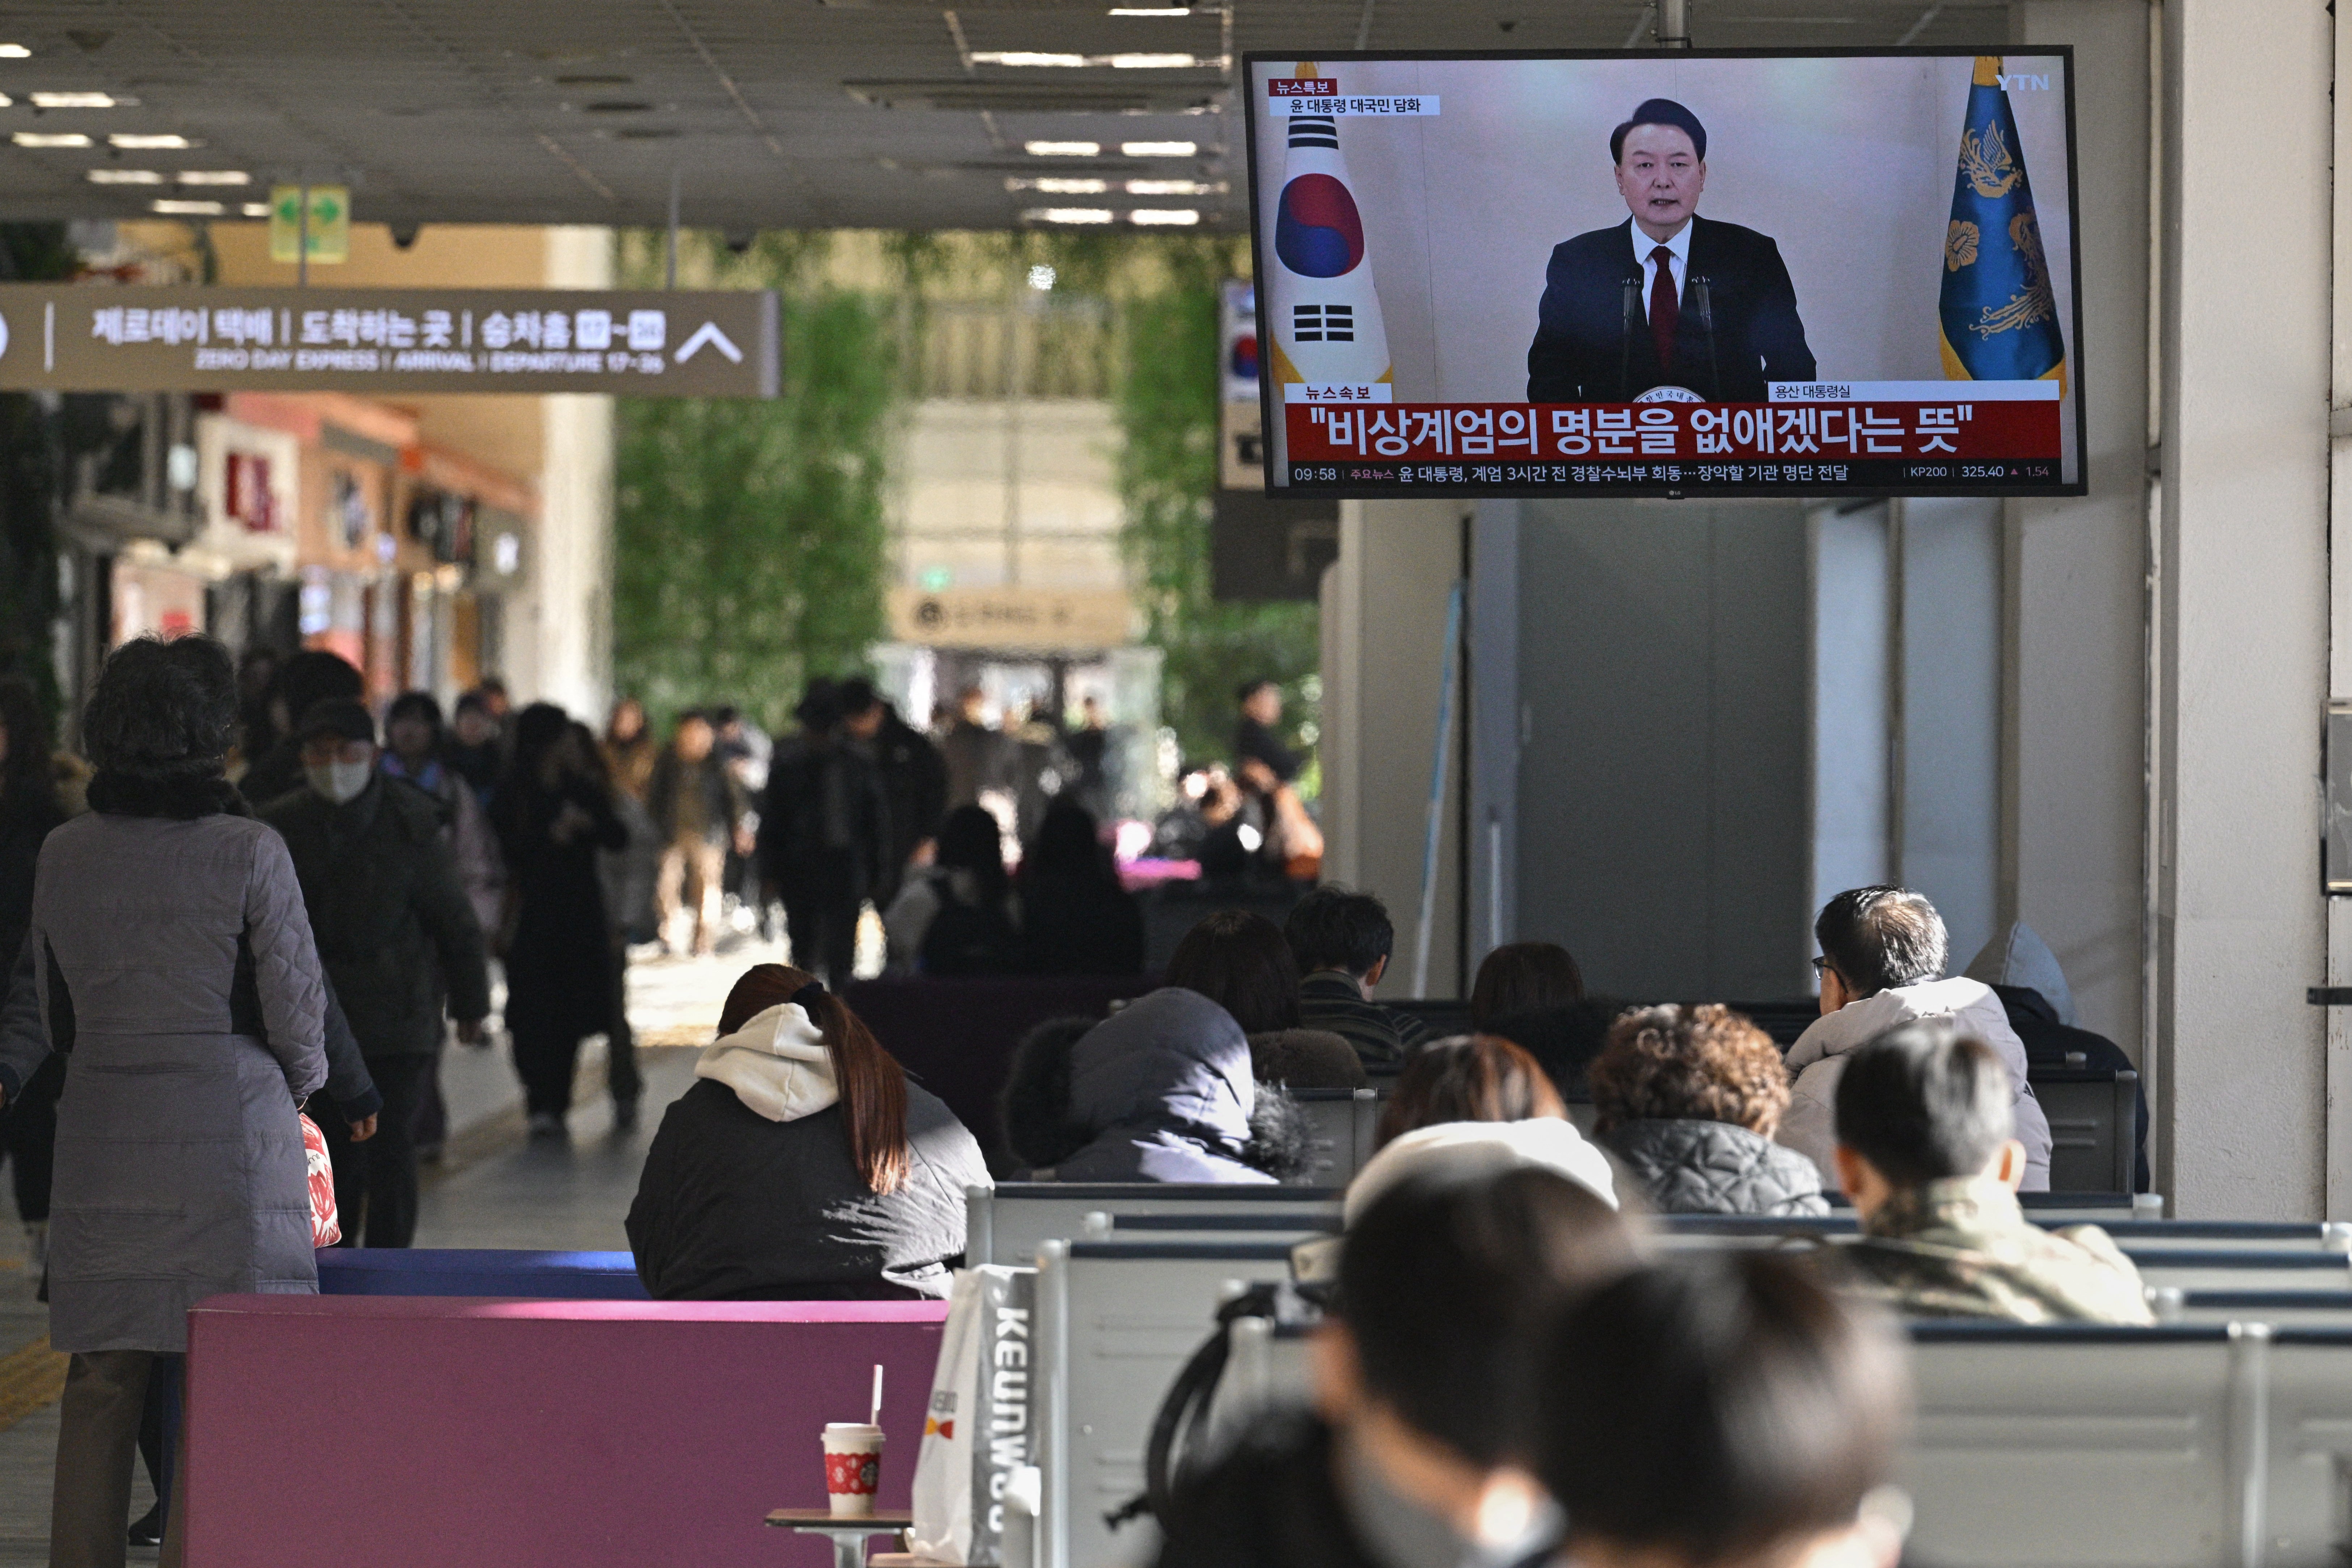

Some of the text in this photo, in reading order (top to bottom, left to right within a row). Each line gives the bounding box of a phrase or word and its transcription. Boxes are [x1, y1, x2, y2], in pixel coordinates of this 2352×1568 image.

[1277, 81, 1330, 95] 뉴스특보
[1995, 75, 2049, 91] YTN
[1290, 98, 1421, 113] 윤 대통령 대국민 담화
[92, 306, 209, 346] 제로데이
[214, 308, 273, 346] 택배
[299, 308, 416, 347] 도착하는
[420, 309, 453, 348] 곳
[481, 310, 572, 349] 승차홈
[195, 348, 249, 370] ZERO
[251, 348, 292, 370] DAY
[294, 348, 379, 371] EXPRESS
[393, 350, 474, 372] ARRIVAL
[489, 351, 603, 372] DEPARTURE
[1306, 386, 1371, 400] 뉴스속보
[1775, 385, 1850, 398] 용산 대통령실
[1310, 405, 1972, 456] "비상계엄의 명분을 없애겠다는 뜻"
[1295, 468, 1336, 481] 09:58
[1350, 469, 1394, 480] 주요뉴스
[1398, 467, 1414, 482] 윤
[1418, 466, 1468, 483] 대통령,
[1472, 466, 1501, 482] 계엄
[1507, 466, 1547, 482] 3시간
[1552, 466, 1566, 482] 전
[1571, 465, 1647, 482] 경찰수뇌부
[1748, 465, 1778, 481] 기관
[1783, 465, 1813, 481] 명단
[1818, 465, 1849, 481] 전달
[1911, 466, 2049, 478] KP200 325.40 1.54
